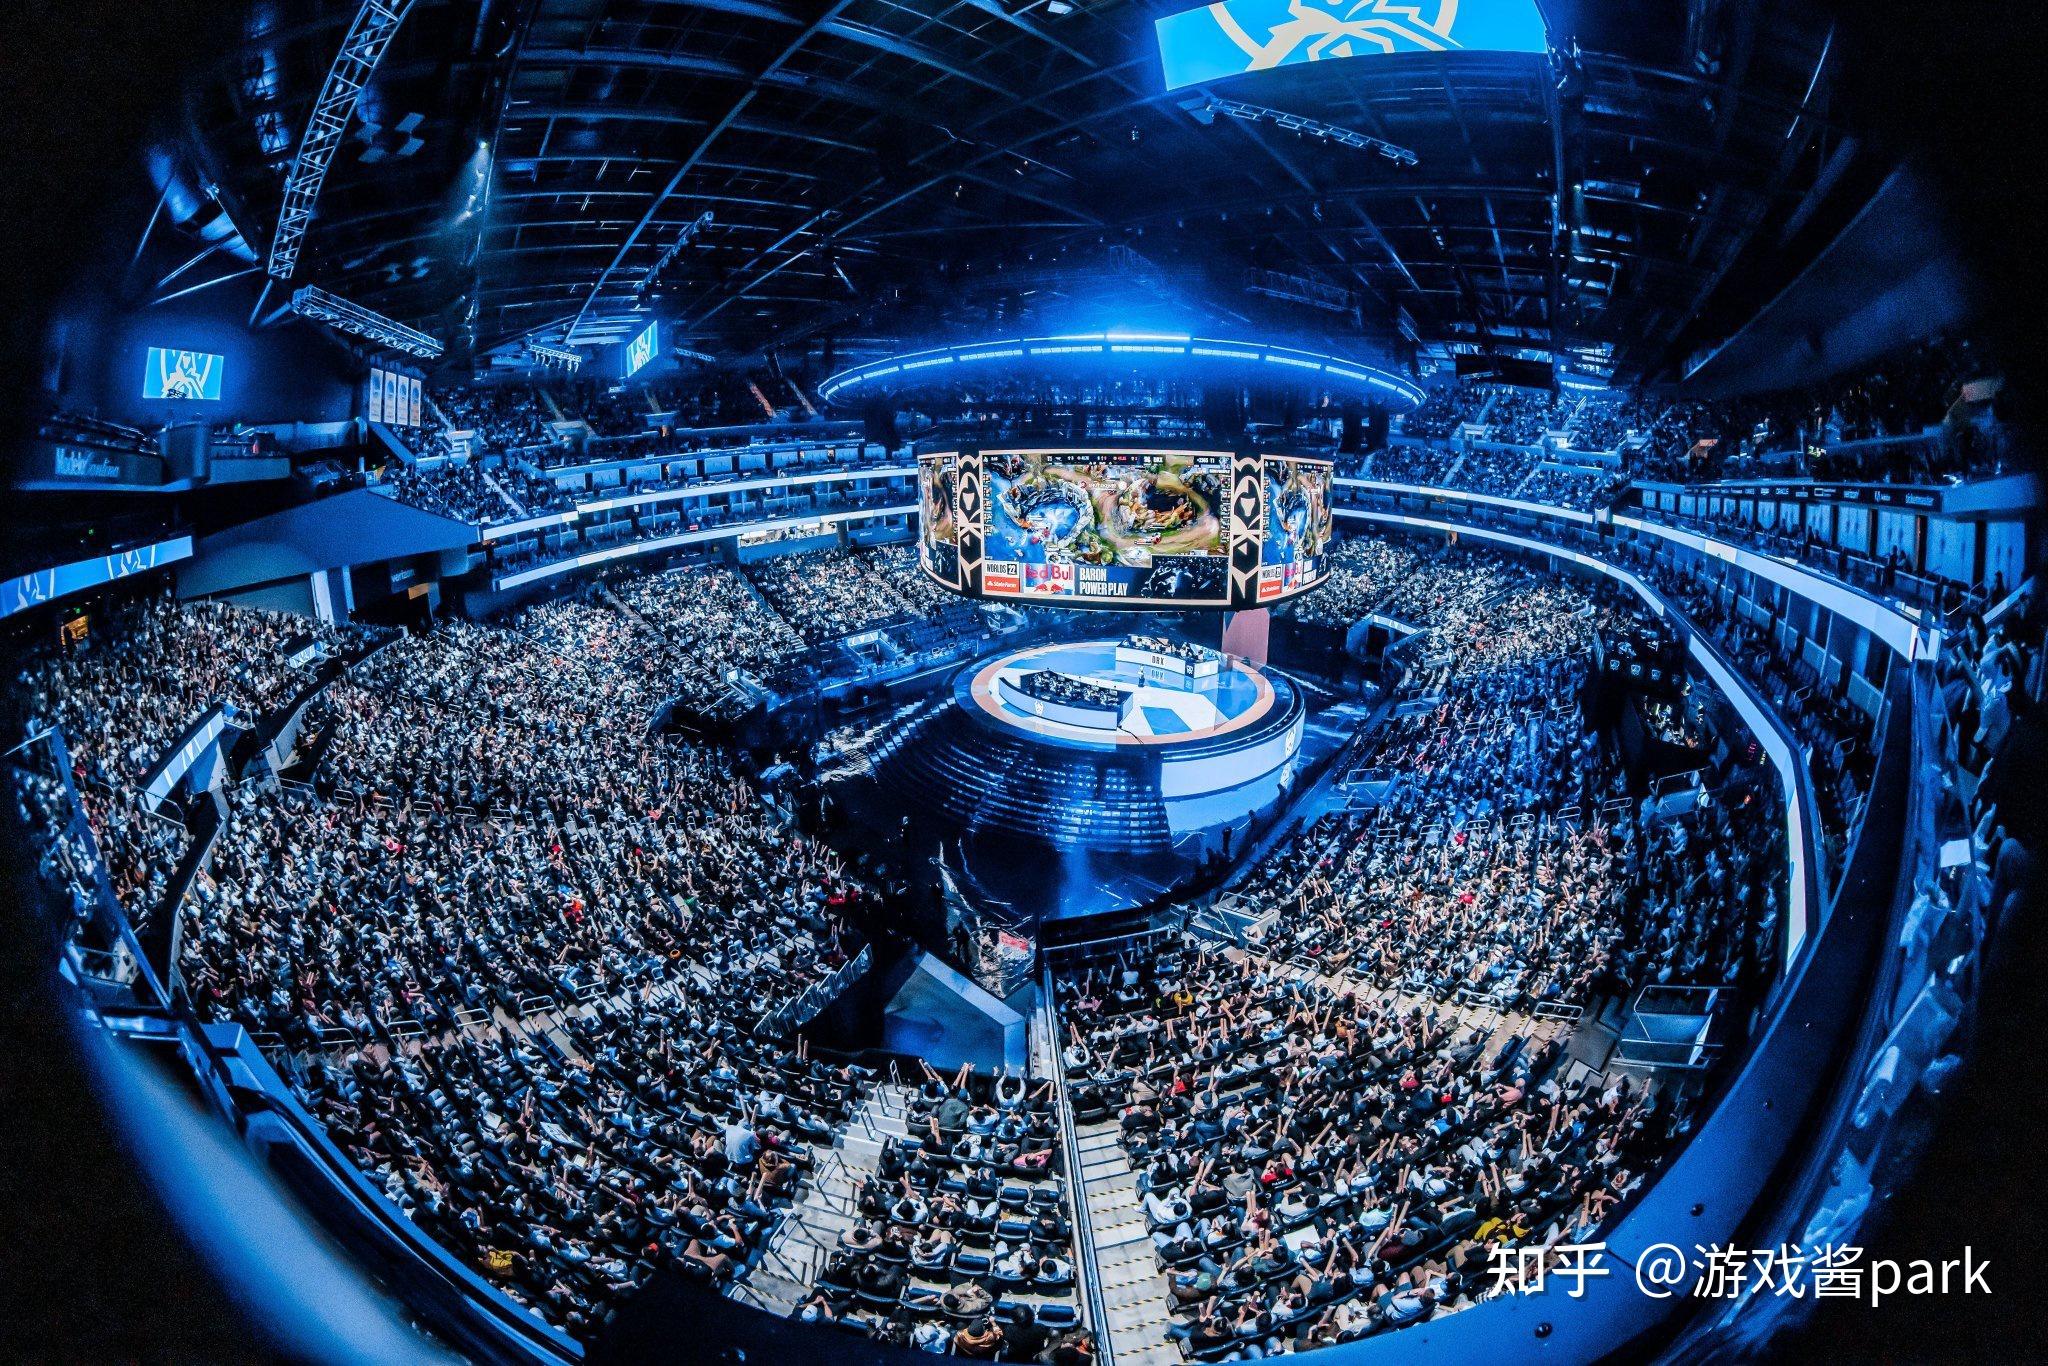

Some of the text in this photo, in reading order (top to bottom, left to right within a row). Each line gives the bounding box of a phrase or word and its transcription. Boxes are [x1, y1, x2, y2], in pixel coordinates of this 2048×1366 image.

[987, 563, 1006, 573] WORLDS
[1079, 567, 1107, 581] BARON
[1080, 581, 1128, 596] POWER PLAY
[1152, 655, 1164, 665] DRX
